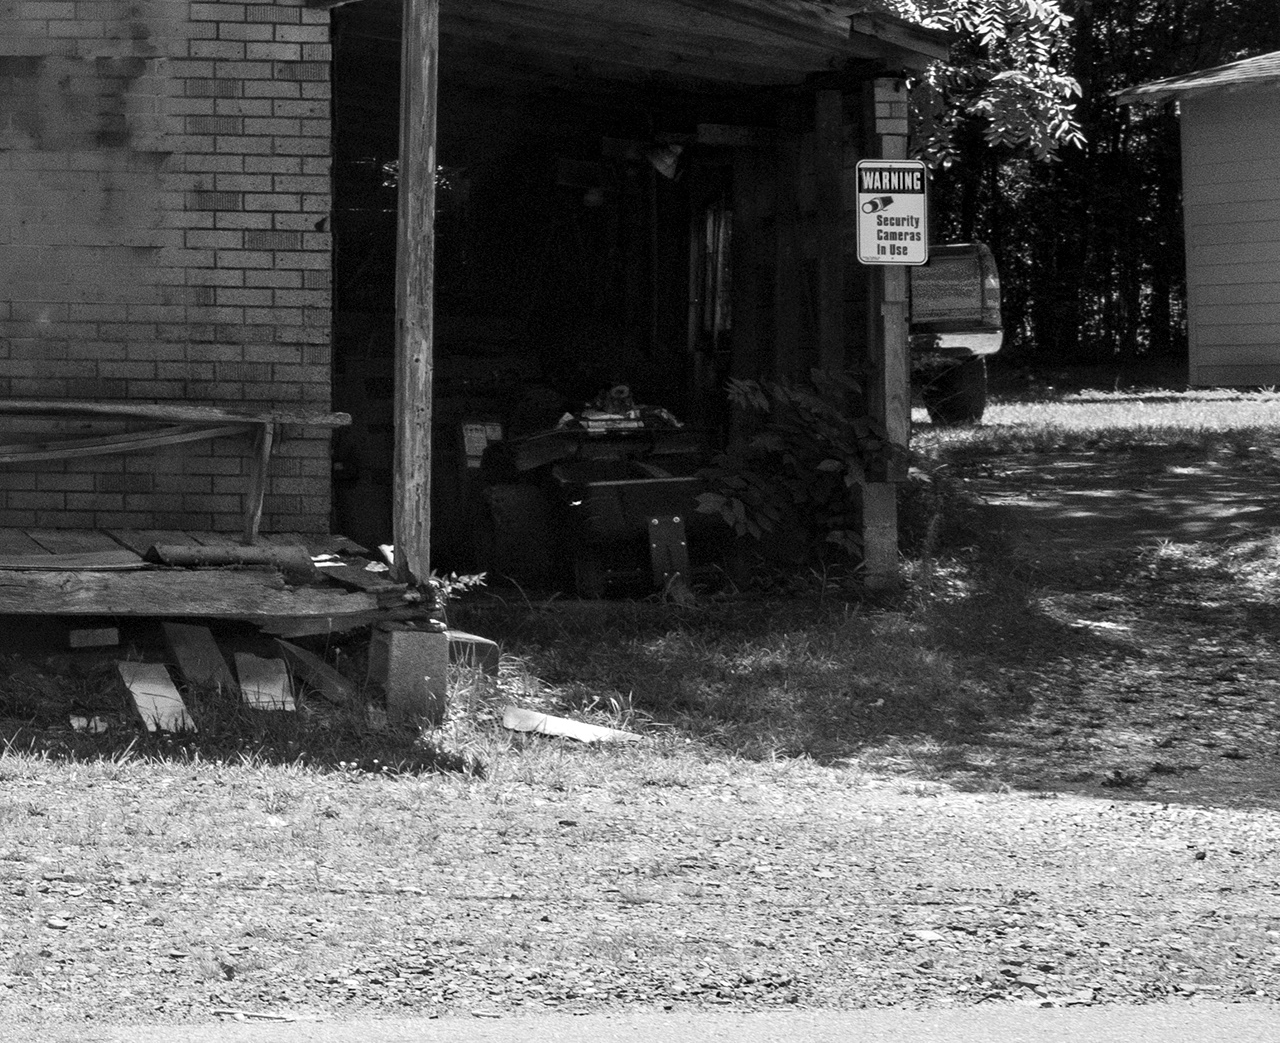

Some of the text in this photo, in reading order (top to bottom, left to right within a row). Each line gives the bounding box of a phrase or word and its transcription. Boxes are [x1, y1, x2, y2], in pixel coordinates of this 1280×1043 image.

[862, 171, 921, 190] WARNING
[877, 214, 920, 229] Security
[877, 229, 921, 241] Cameras
[877, 243, 908, 256] In Use
